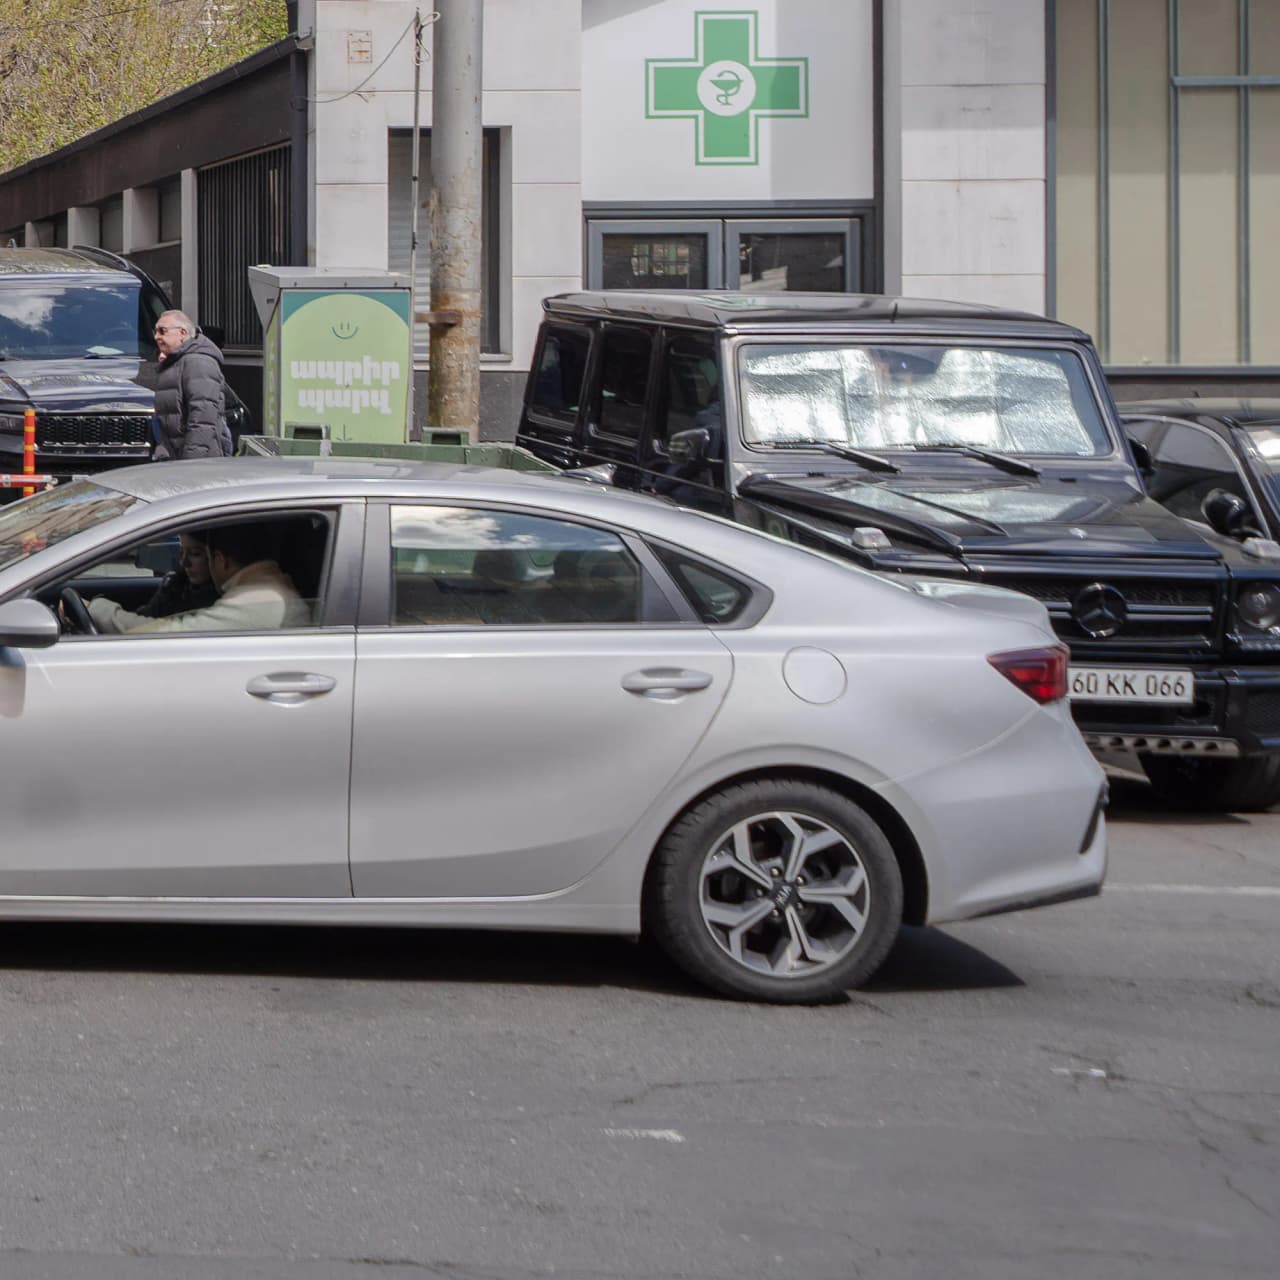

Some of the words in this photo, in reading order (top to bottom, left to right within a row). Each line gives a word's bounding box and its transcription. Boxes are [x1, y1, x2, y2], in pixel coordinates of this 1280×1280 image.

[1073, 672, 1098, 694] 60
[1106, 673, 1137, 696] KK
[1146, 674, 1185, 697] 066
